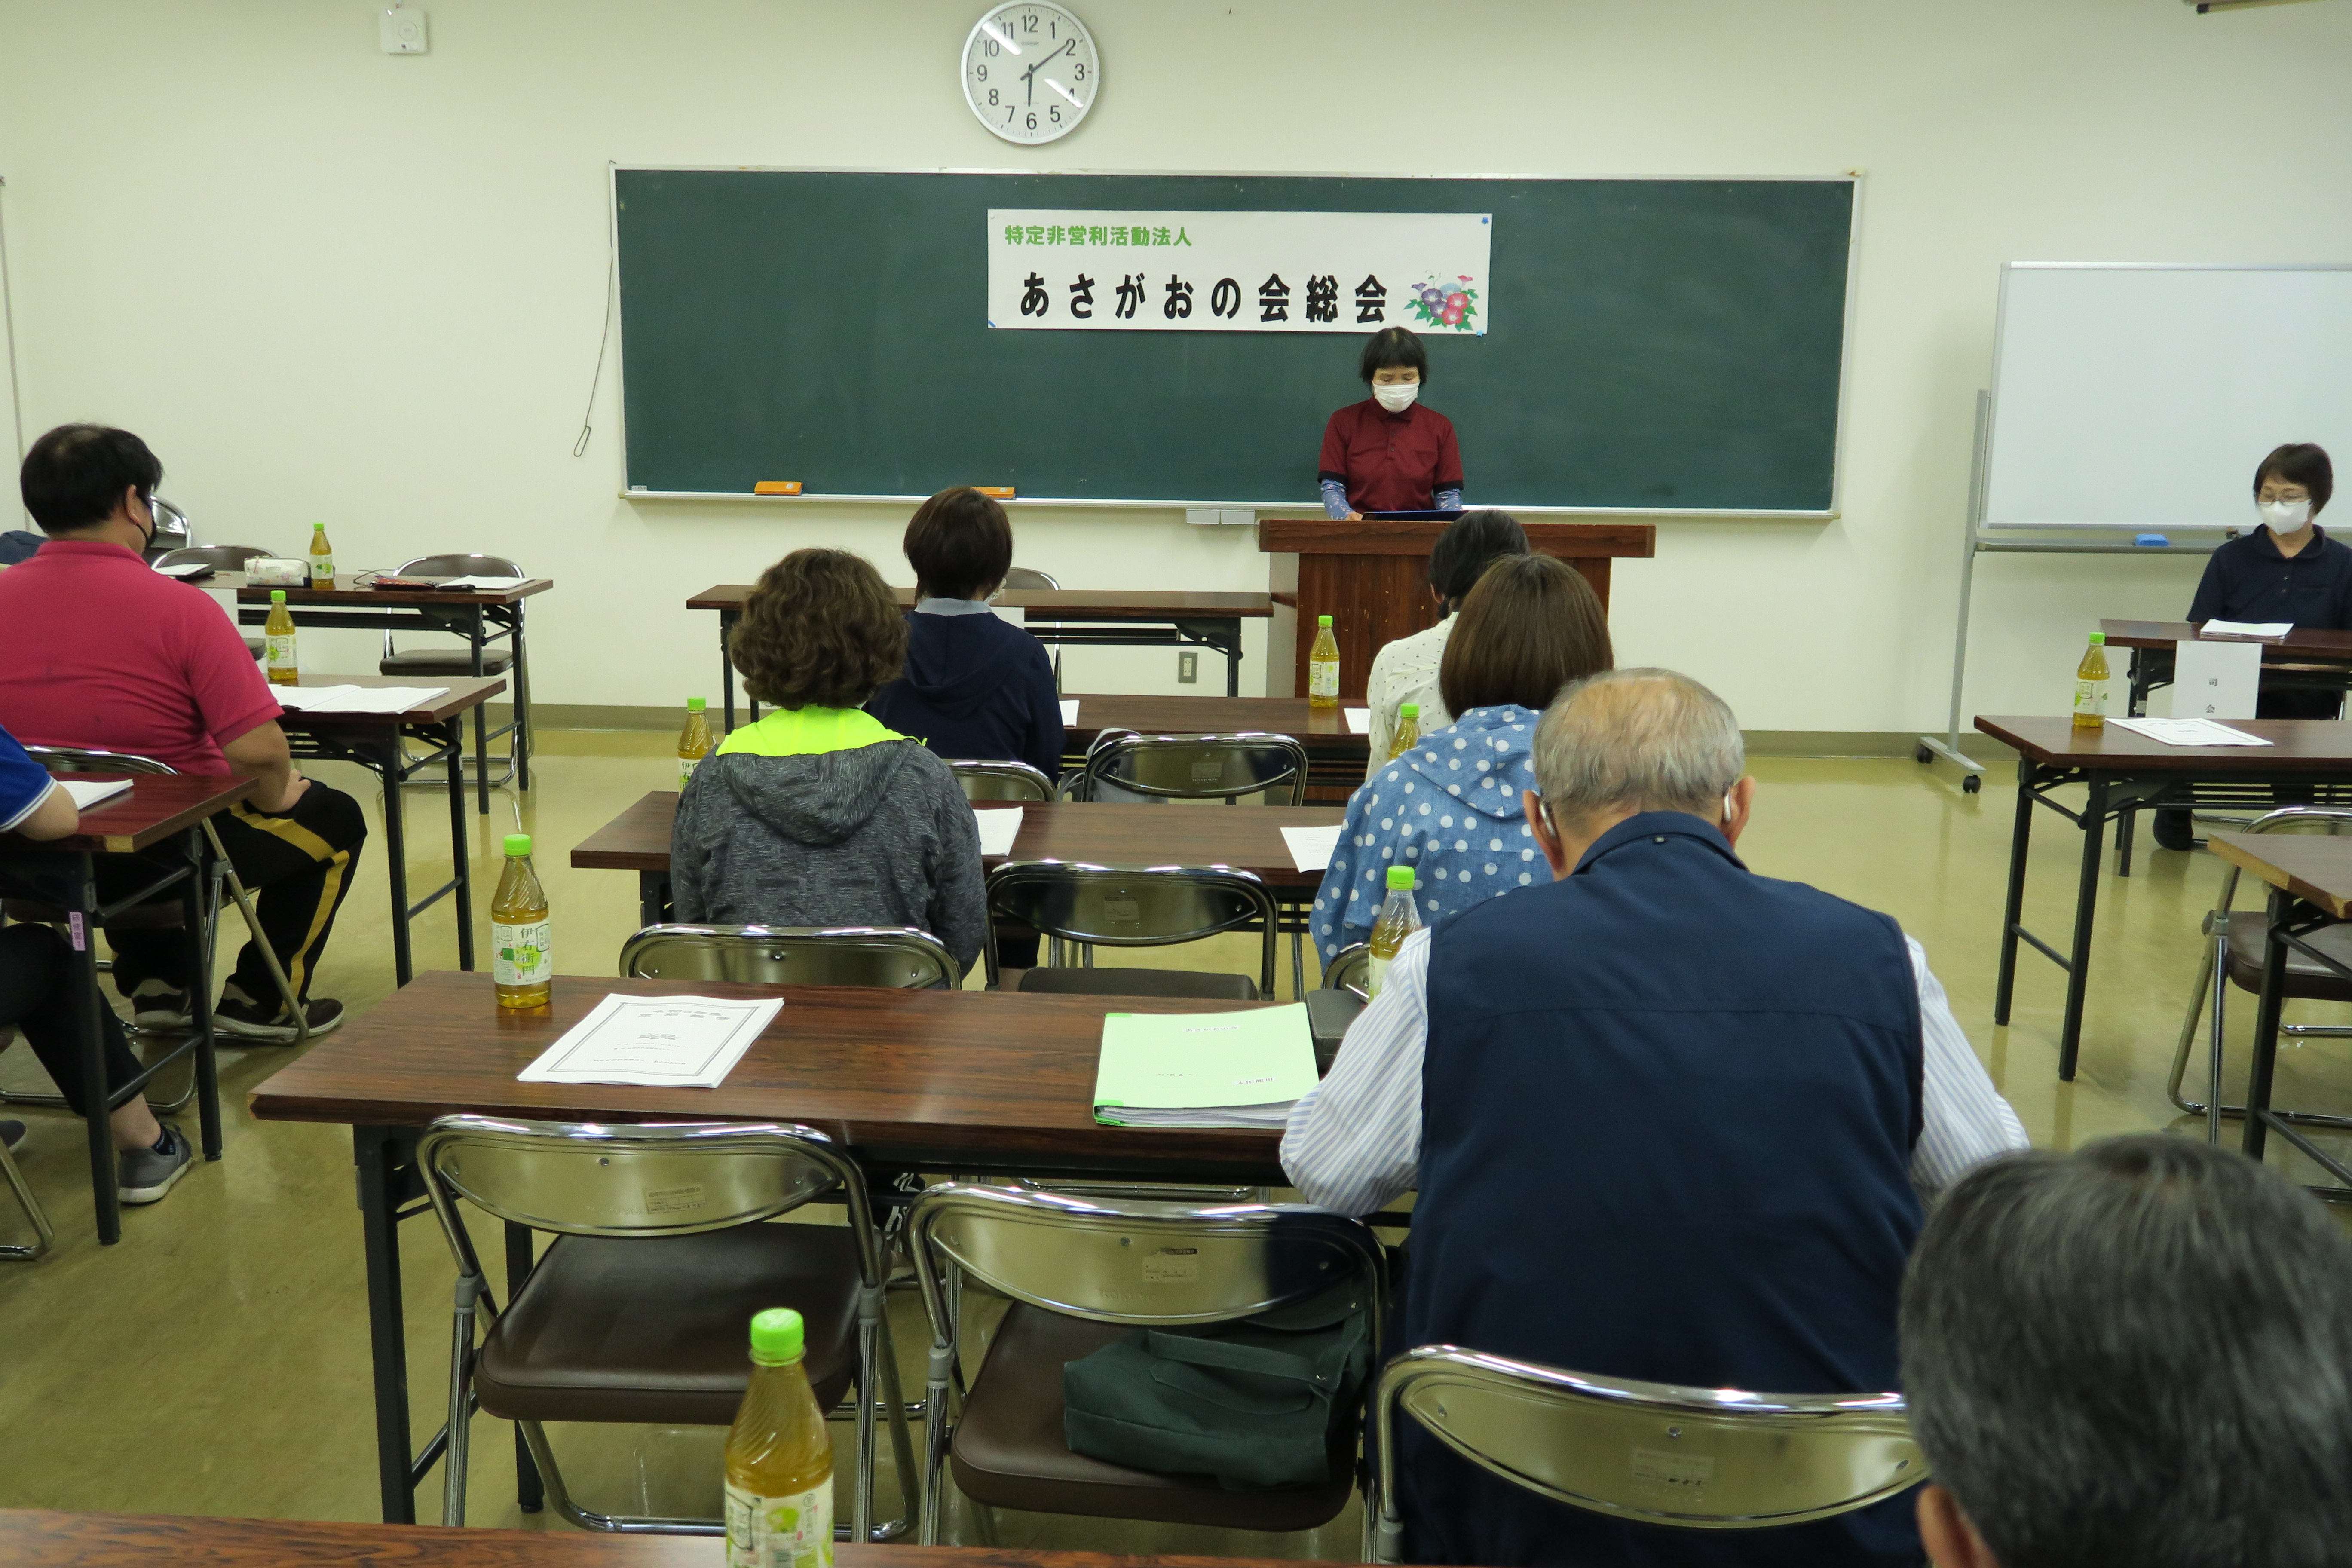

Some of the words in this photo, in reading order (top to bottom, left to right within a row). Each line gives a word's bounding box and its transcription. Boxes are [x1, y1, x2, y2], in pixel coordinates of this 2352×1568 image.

[1001, 22, 1014, 39] 11
[1021, 15, 1038, 33] 12
[1050, 21, 1056, 39] 1
[982, 40, 999, 57] 10
[1066, 38, 1076, 56] 2
[977, 64, 988, 82] 9
[1074, 63, 1085, 81] 3
[989, 88, 999, 106] 8
[1005, 106, 1015, 123] 7
[1026, 113, 1037, 130] 6
[1050, 105, 1060, 122] 5
[1005, 225, 1192, 247] 特定非営利活動法人
[1020, 272, 1387, 324] あさがおの会総会
[2205, 678, 2218, 713] 司会
[521, 928, 535, 976] 伊右衛門
